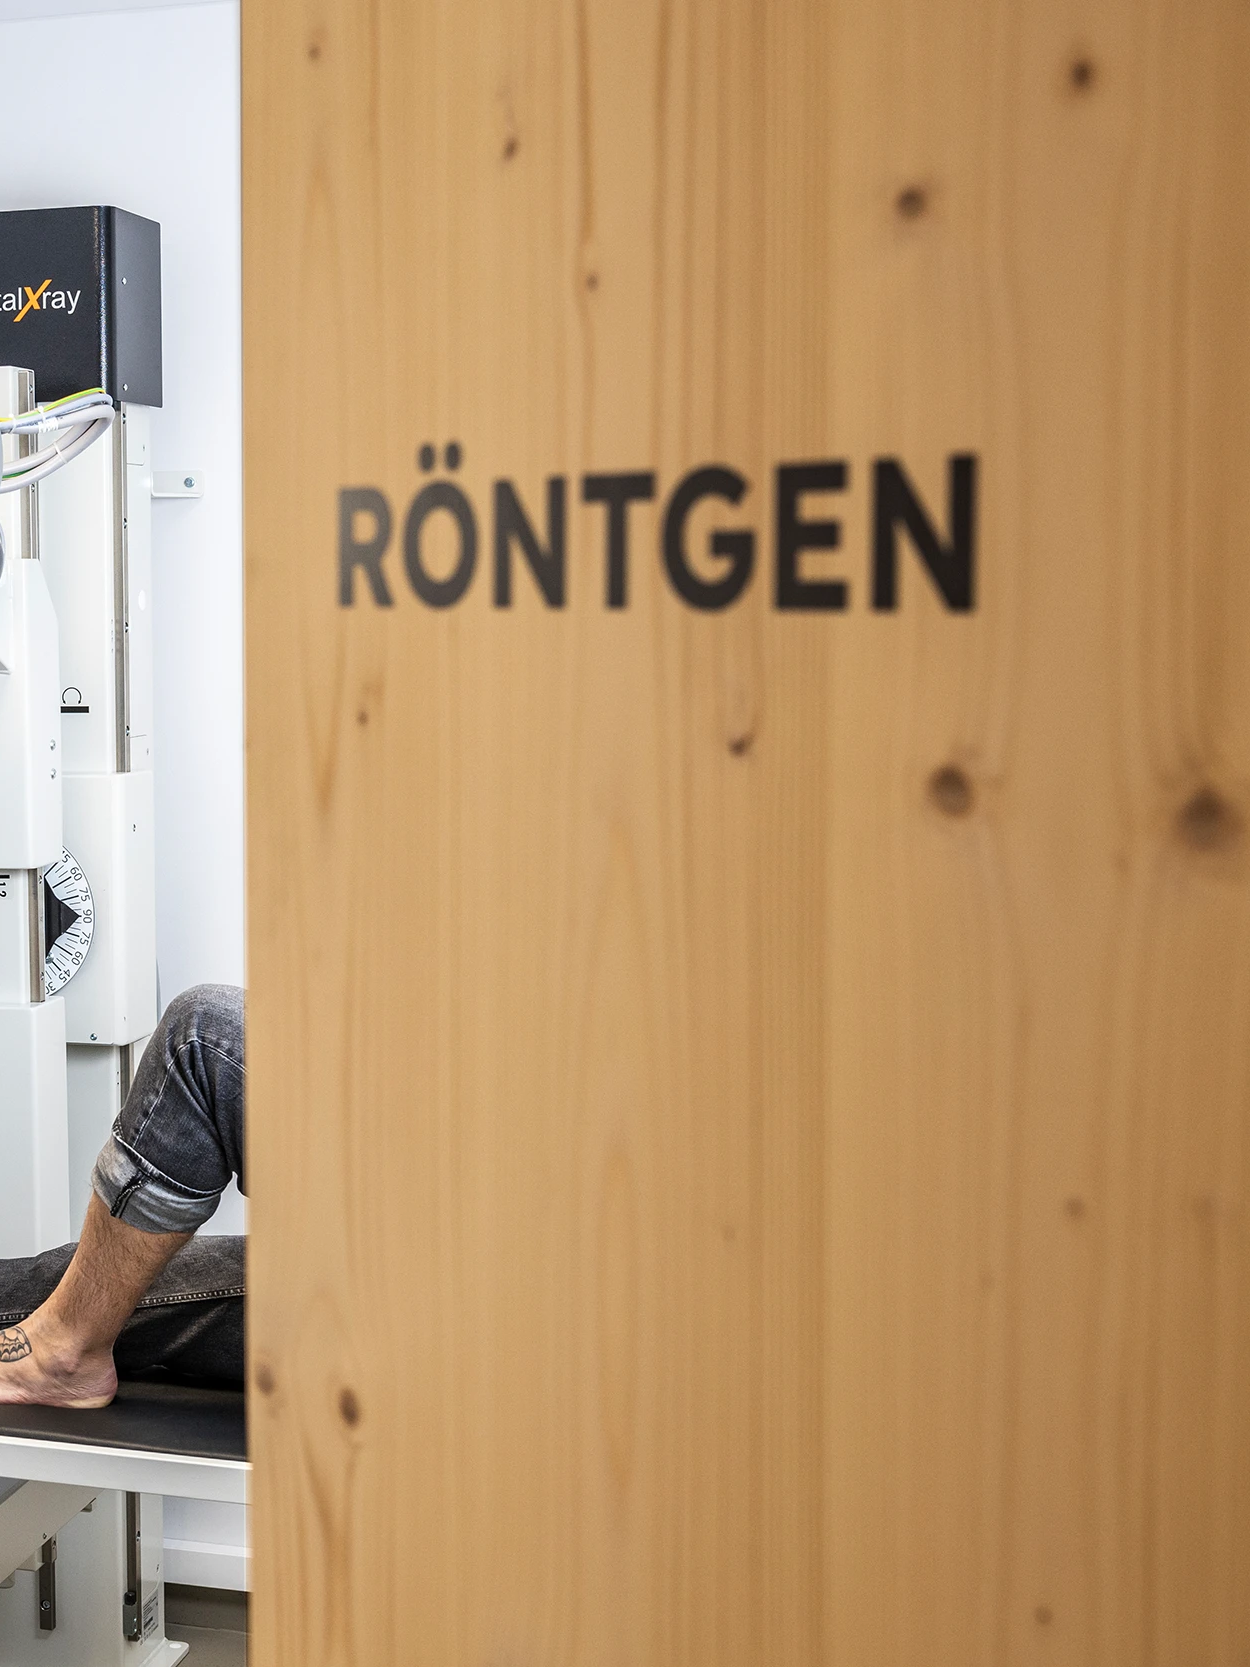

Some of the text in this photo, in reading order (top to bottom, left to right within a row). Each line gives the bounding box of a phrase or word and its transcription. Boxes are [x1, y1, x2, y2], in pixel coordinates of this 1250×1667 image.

[337, 441, 979, 613] RÖNTGEN
[70, 866, 83, 882] 60
[78, 887, 91, 902] 75
[82, 909, 93, 924] 90
[79, 931, 91, 946] 75
[71, 950, 84, 966] 60
[58, 968, 71, 983] 45
